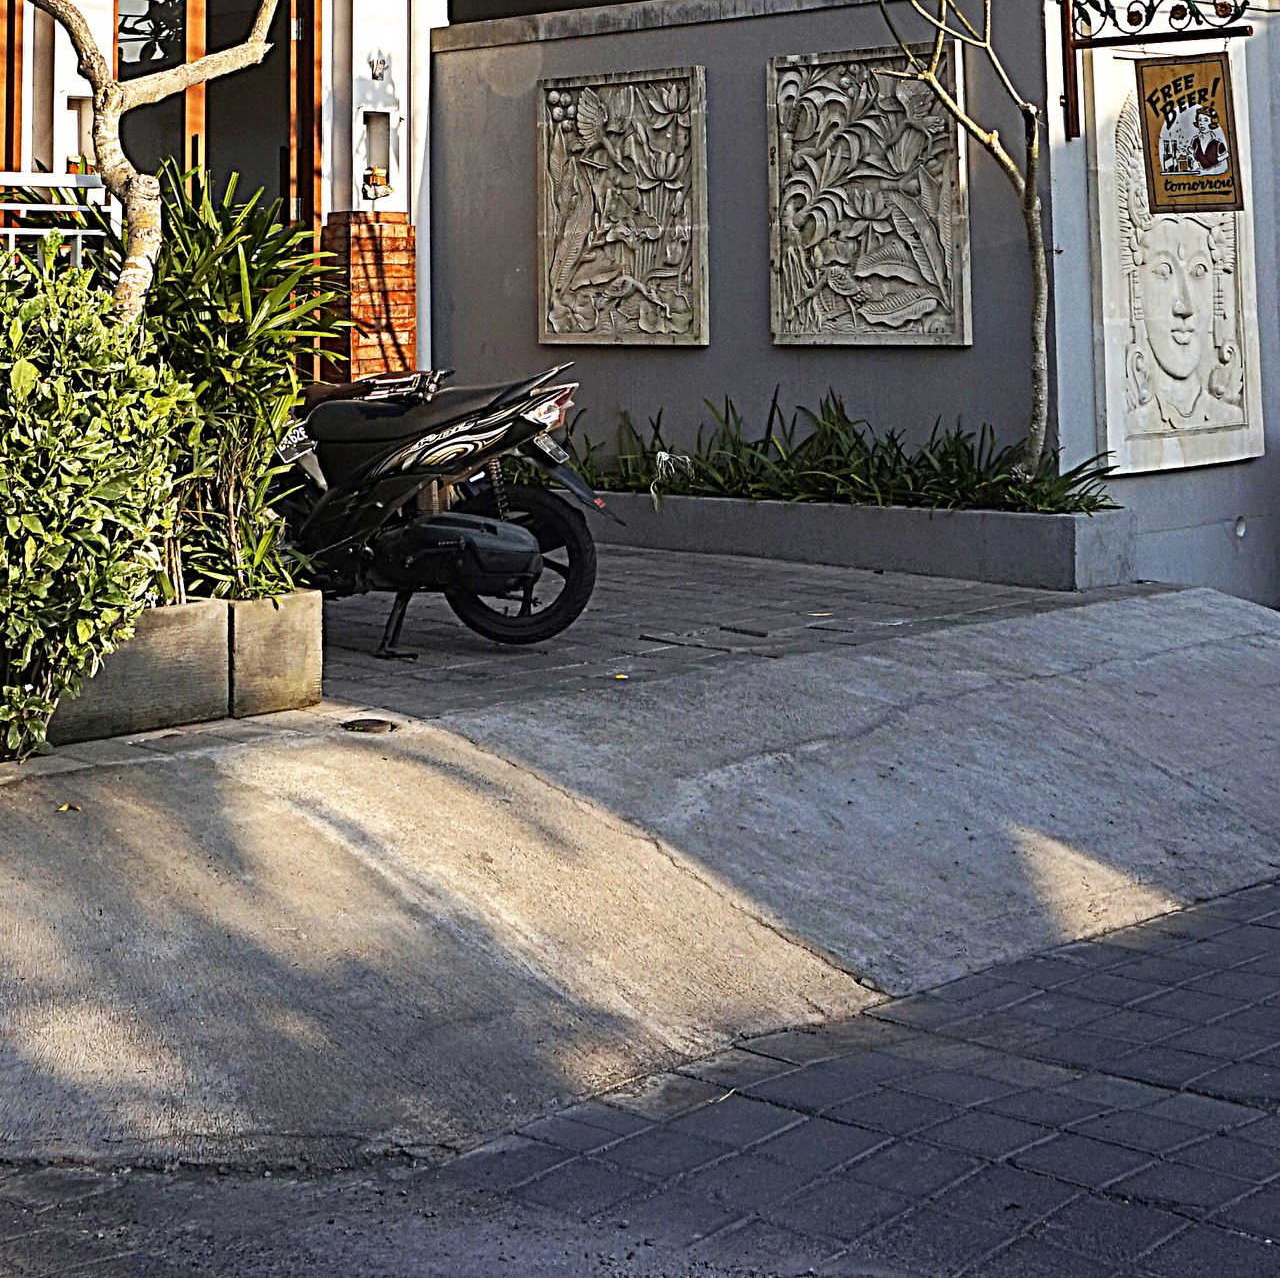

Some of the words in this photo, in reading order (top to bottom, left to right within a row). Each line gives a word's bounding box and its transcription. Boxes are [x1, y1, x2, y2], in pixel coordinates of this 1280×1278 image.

[1146, 73, 1195, 119] FREE
[1160, 77, 1221, 131] BEER!
[1164, 176, 1235, 192] tomorrow
